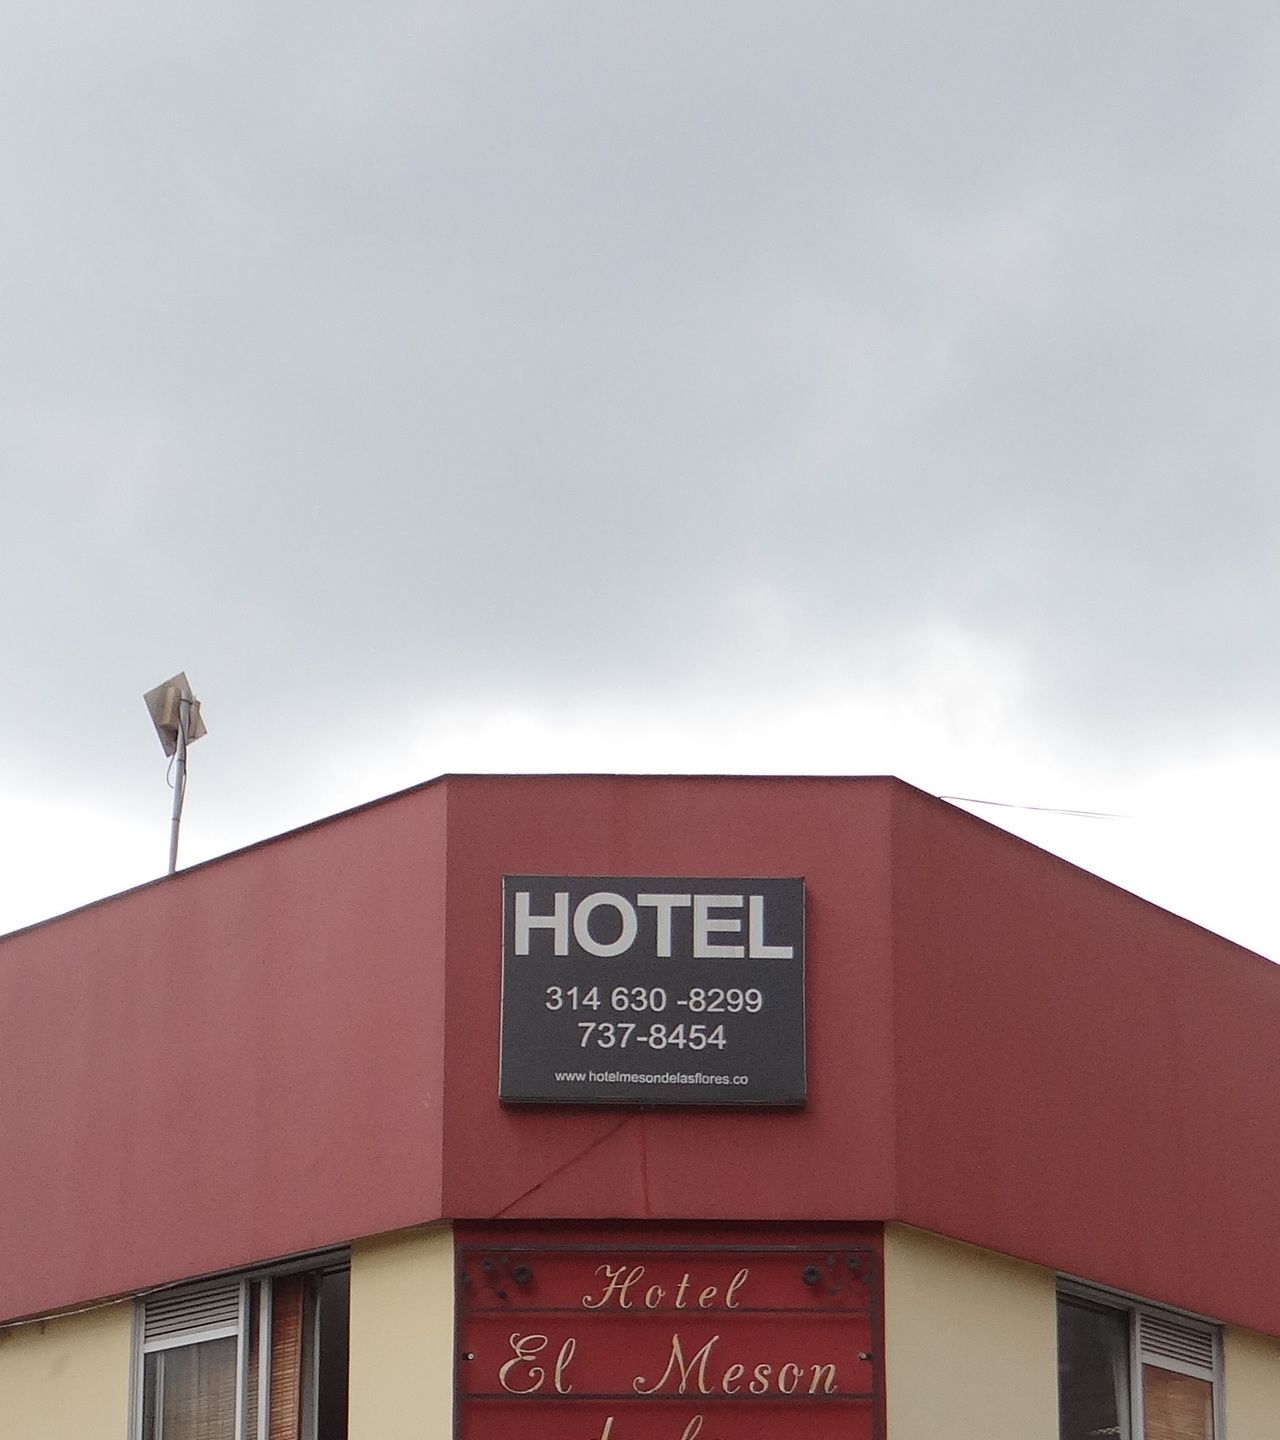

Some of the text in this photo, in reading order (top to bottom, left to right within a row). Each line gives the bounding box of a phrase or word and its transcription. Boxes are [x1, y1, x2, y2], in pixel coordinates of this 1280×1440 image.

[514, 891, 794, 960] HOTEL
[544, 986, 763, 1014] 314 630 -8299
[577, 1022, 727, 1051] 737-8454
[581, 1264, 750, 1310] Hotel
[498, 1332, 839, 1395] El Meson
